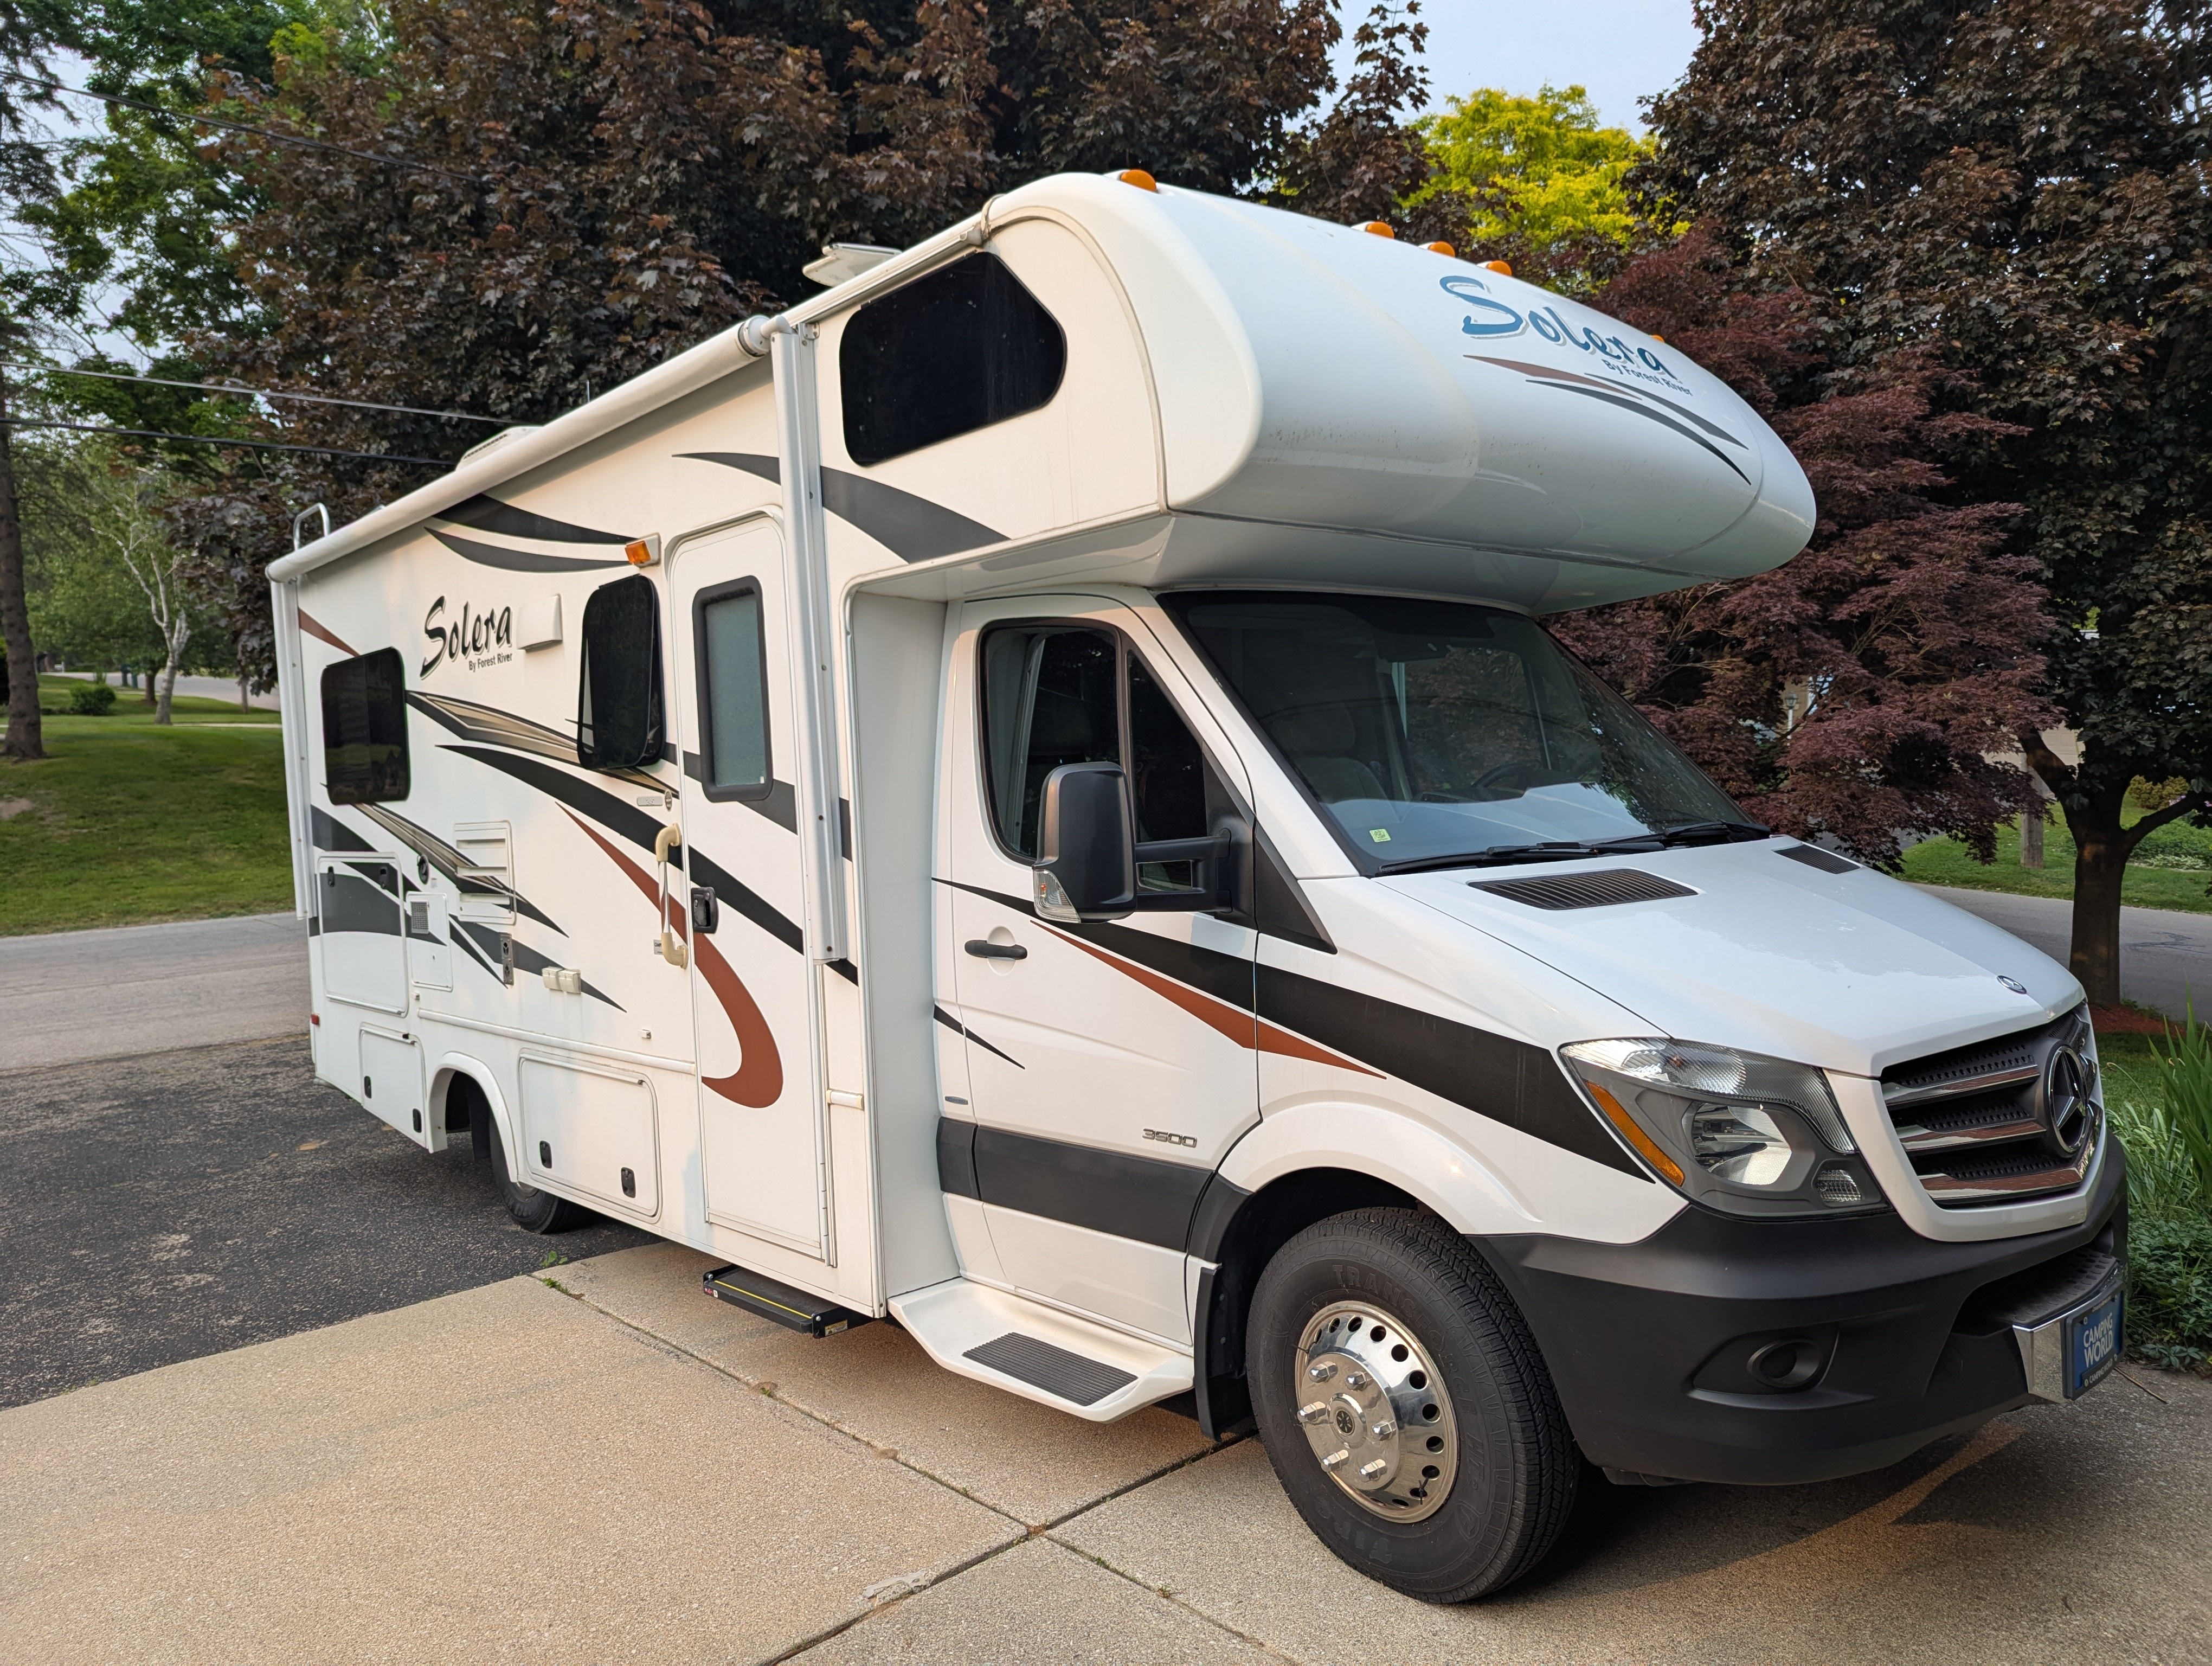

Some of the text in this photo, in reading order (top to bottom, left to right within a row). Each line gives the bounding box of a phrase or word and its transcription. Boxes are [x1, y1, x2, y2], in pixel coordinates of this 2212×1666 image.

[1439, 275, 1681, 383] Solera
[1601, 358, 1693, 396] By Forest River
[419, 595, 513, 681] Solera
[468, 652, 513, 672] By Forest River
[1142, 1128, 1197, 1148] 3500
[1332, 1264, 1477, 1415] TRANSFORCE
[2083, 1312, 2113, 1348] CAMPING
[2084, 1330, 2113, 1368] WORLD
[2089, 1368, 2105, 1383] CAMPING
